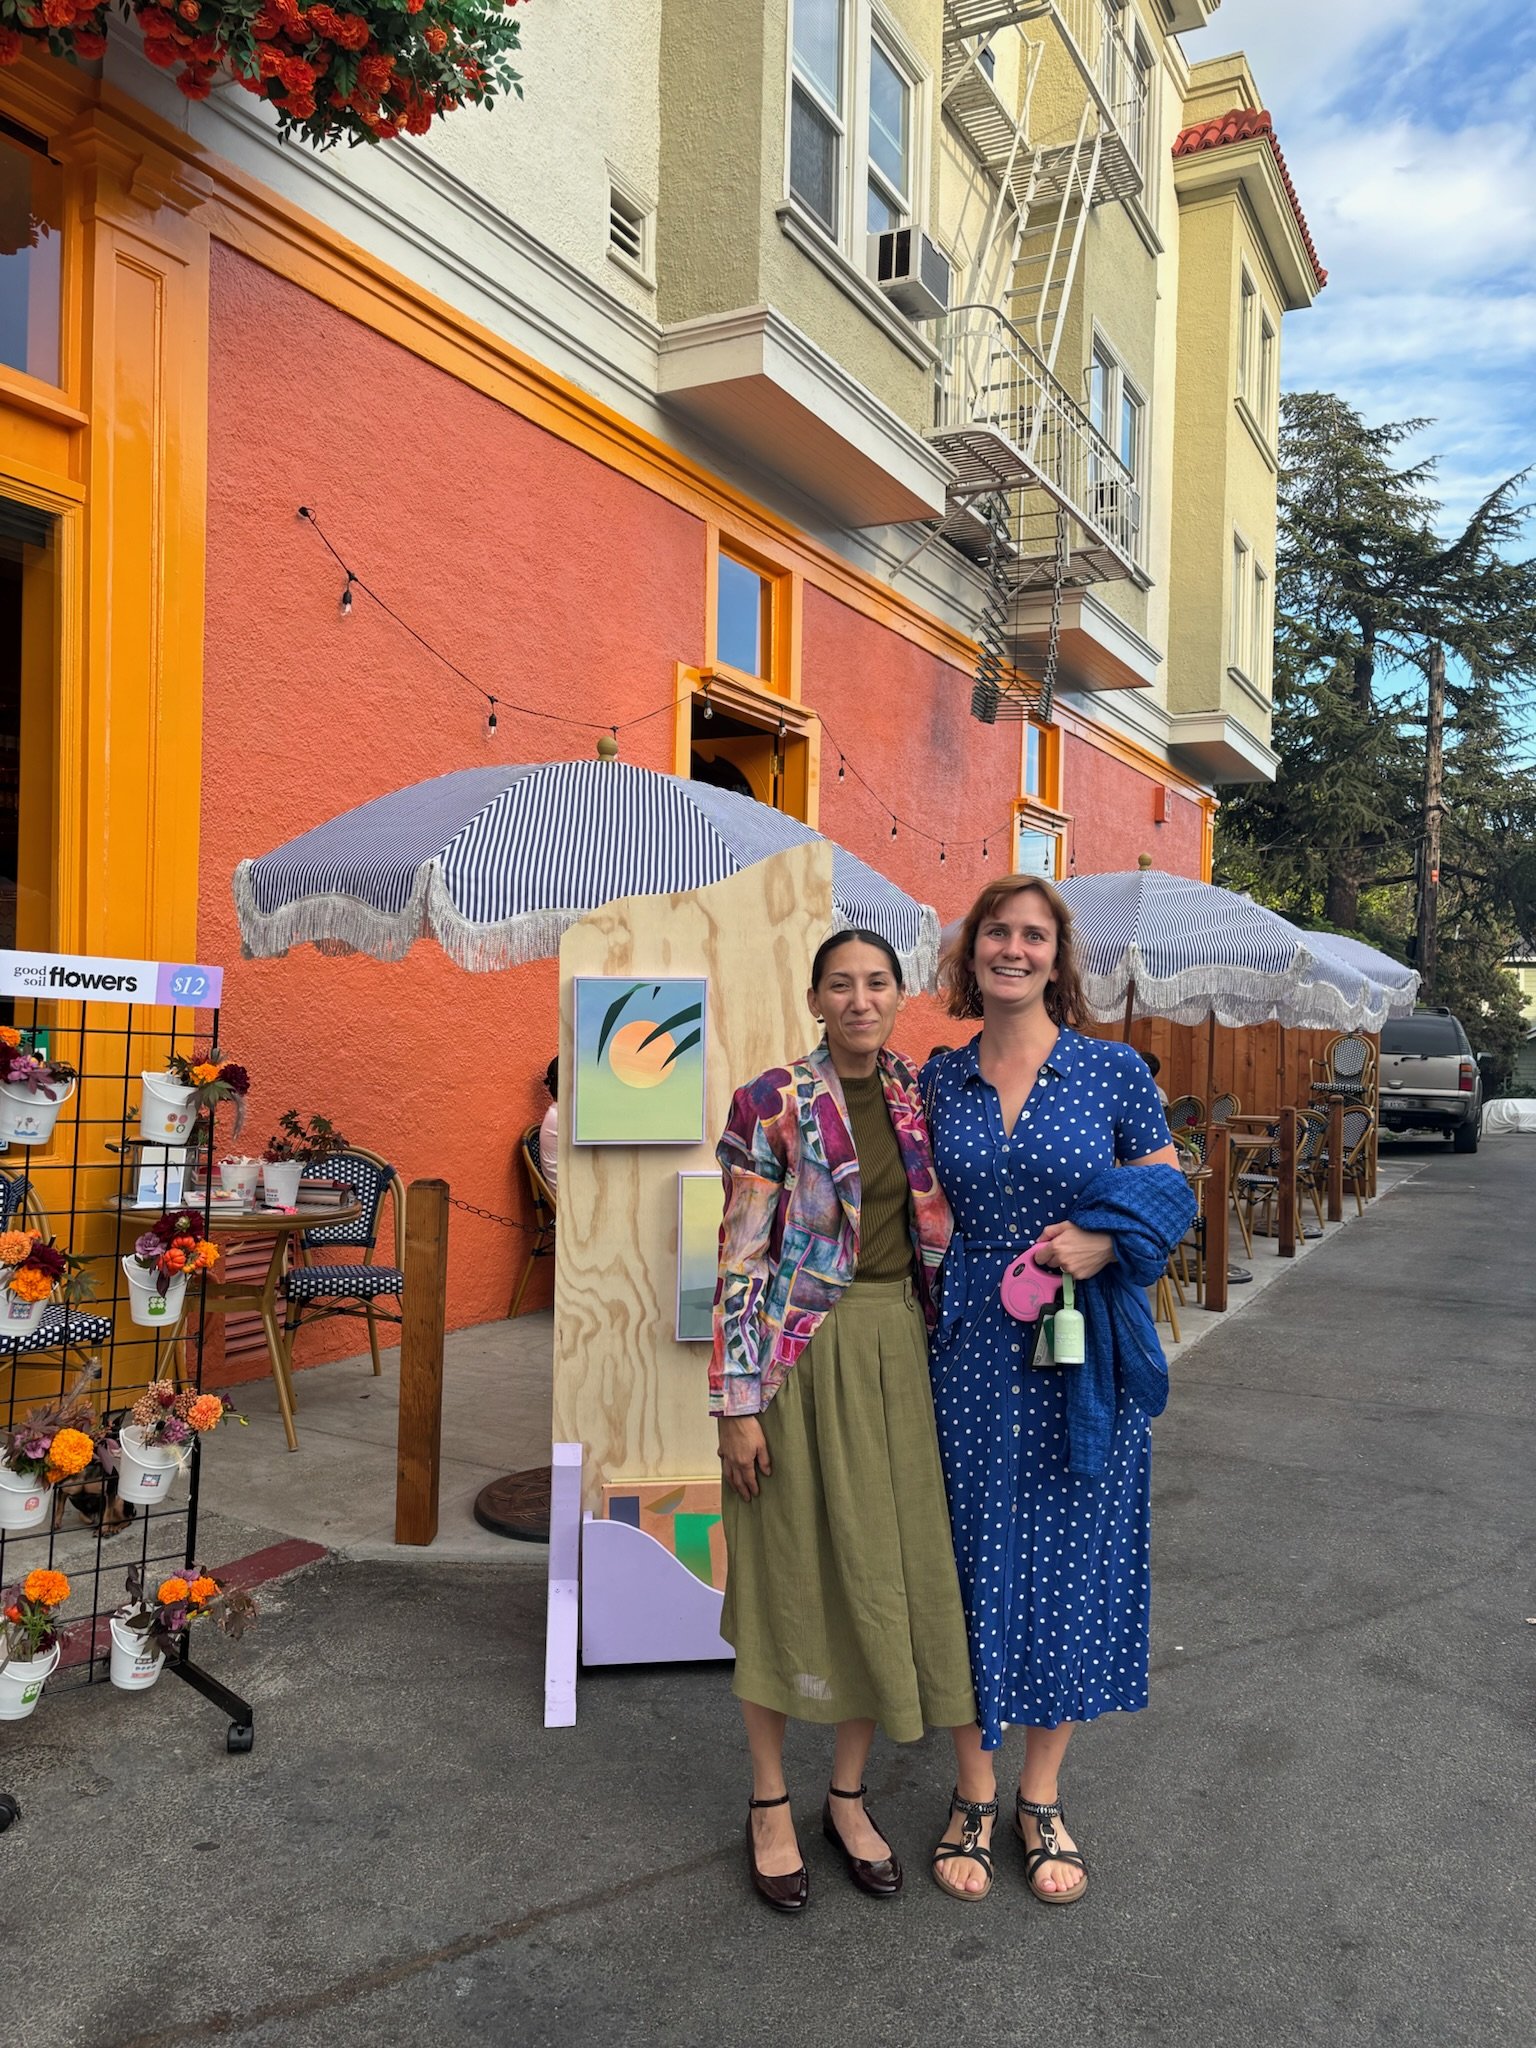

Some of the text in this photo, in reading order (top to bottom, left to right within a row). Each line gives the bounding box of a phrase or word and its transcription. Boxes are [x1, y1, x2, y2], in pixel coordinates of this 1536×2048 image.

[14, 966, 47, 976] good
[24, 976, 46, 987] soil
[49, 966, 138, 992] flowers
[173, 976, 205, 995] $12
